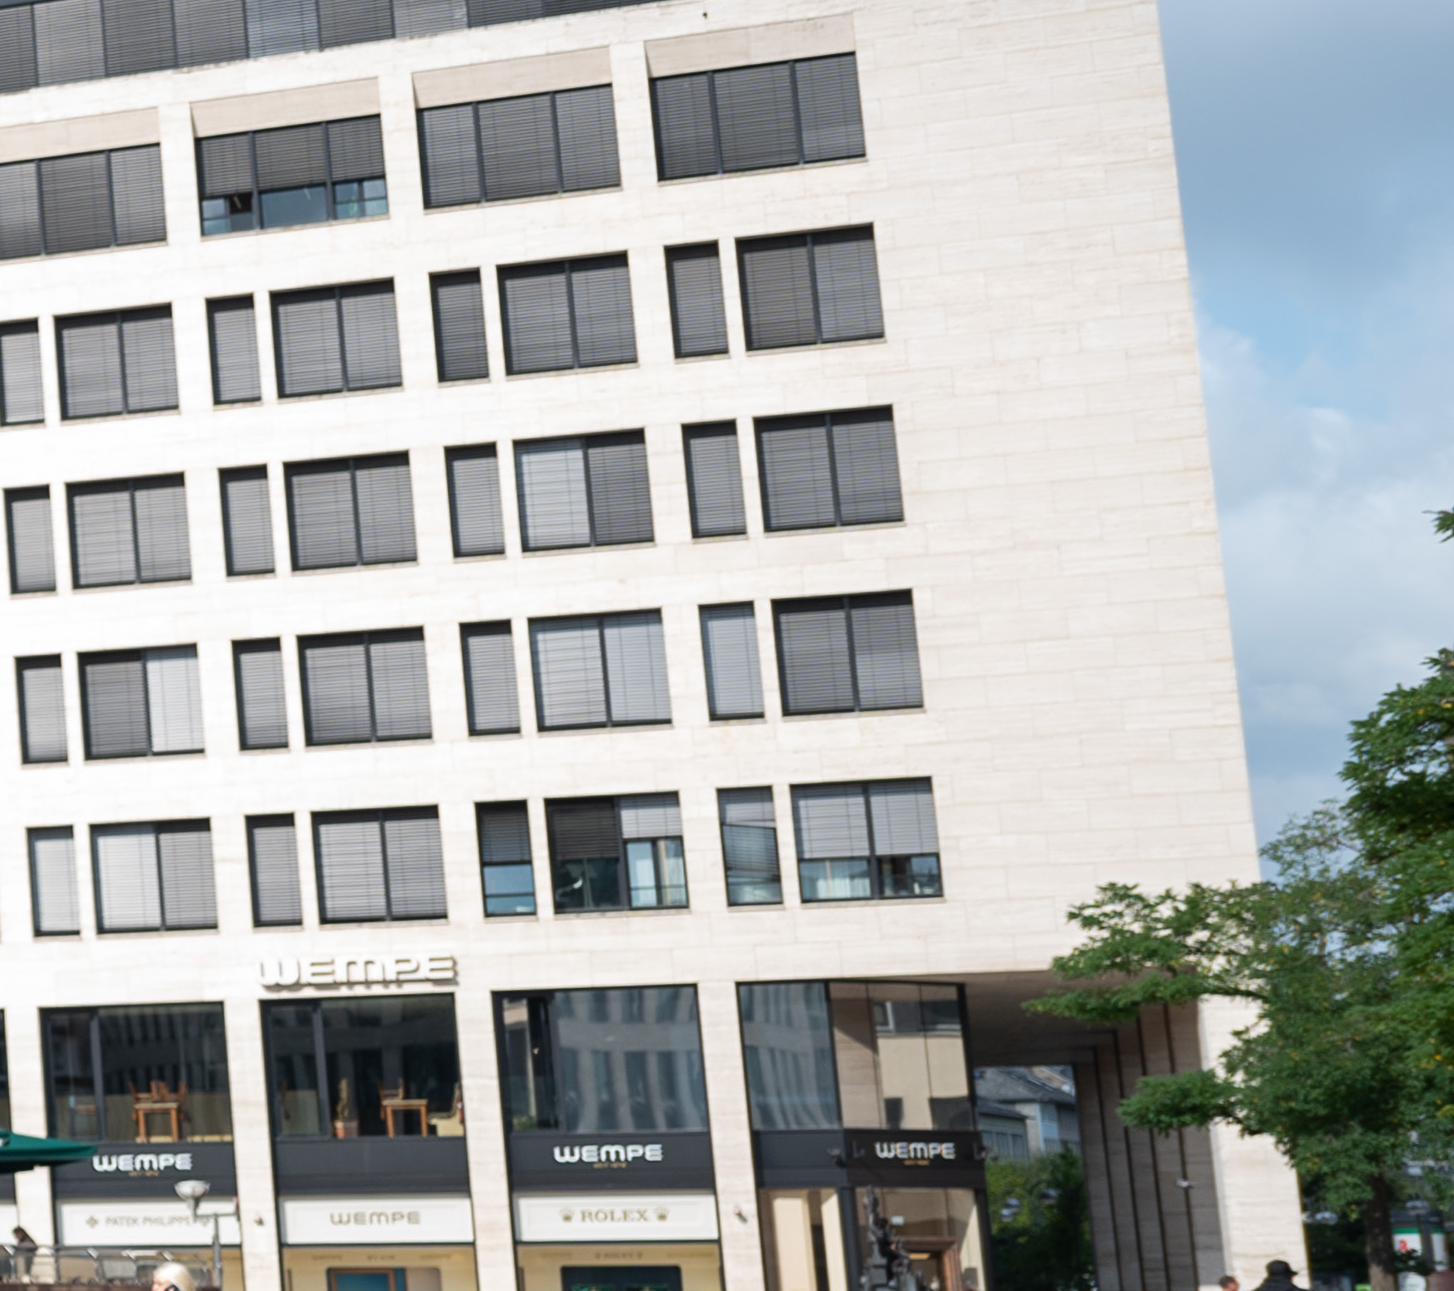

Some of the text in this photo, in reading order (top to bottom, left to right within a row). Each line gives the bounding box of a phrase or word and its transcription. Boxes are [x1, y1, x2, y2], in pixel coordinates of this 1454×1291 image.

[259, 956, 456, 985] WEMPE
[553, 1144, 663, 1163] WEMPE
[875, 1142, 955, 1159] WEMPE
[92, 1153, 192, 1172] WEMPE
[329, 1211, 422, 1226] WEMPE
[580, 1209, 649, 1223] ROLEX
